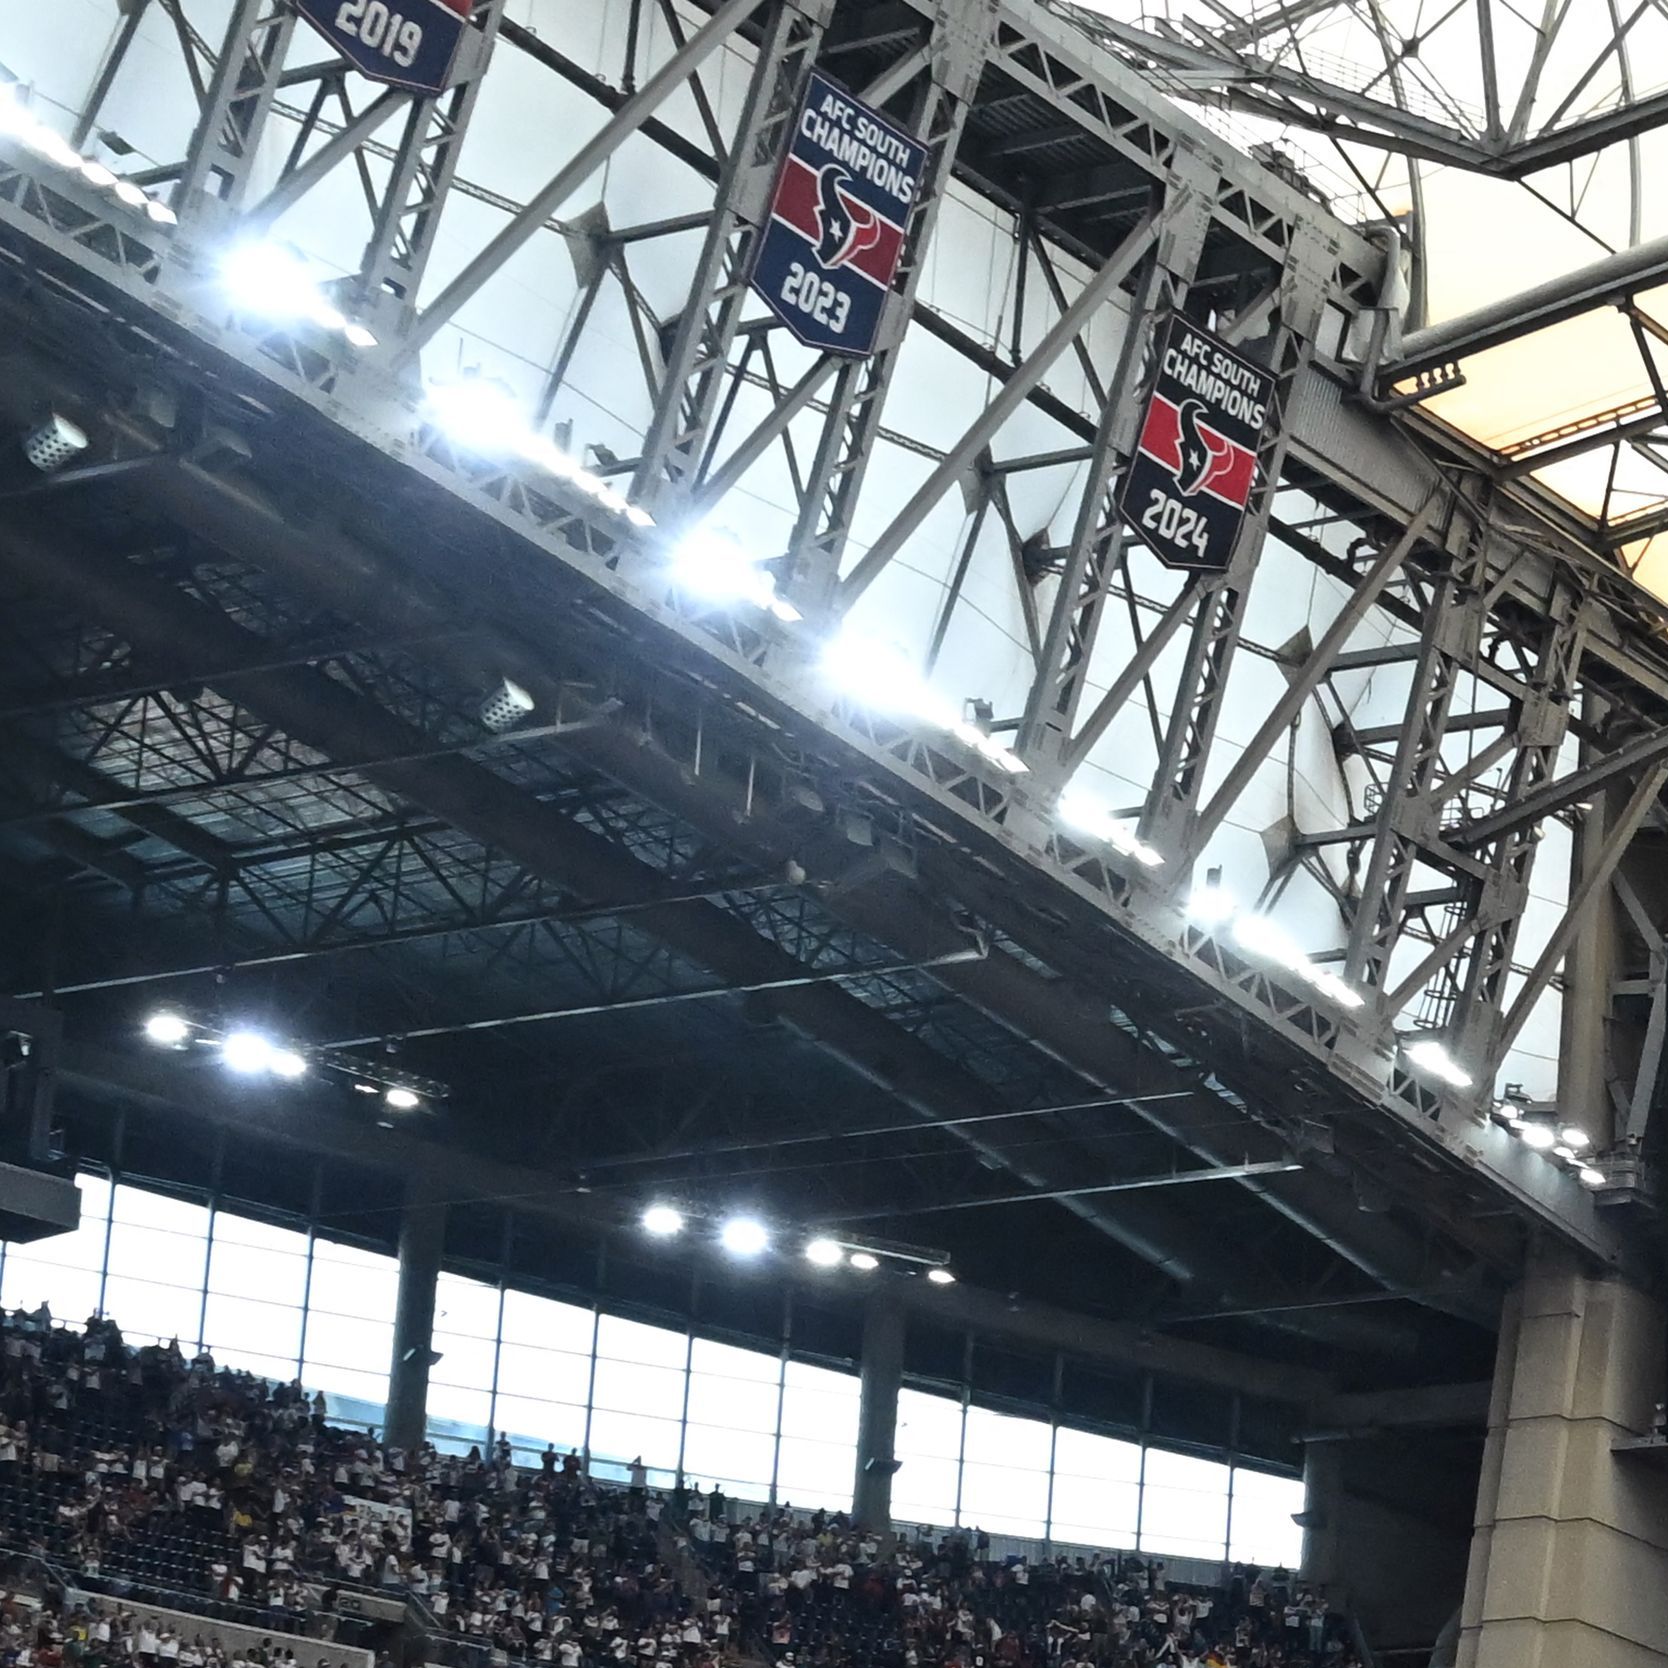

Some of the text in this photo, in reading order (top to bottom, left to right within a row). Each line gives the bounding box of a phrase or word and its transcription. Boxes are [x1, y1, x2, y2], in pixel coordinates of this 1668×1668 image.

[335, 0, 422, 67] 2019
[801, 108, 915, 203] CHAMPIONS
[820, 94, 910, 168] AFC SOUTH
[780, 262, 851, 334] 2023
[1163, 348, 1266, 430] CHAMPIONS
[1180, 333, 1261, 398] AFC SOUTH
[1142, 489, 1209, 558] 2024
